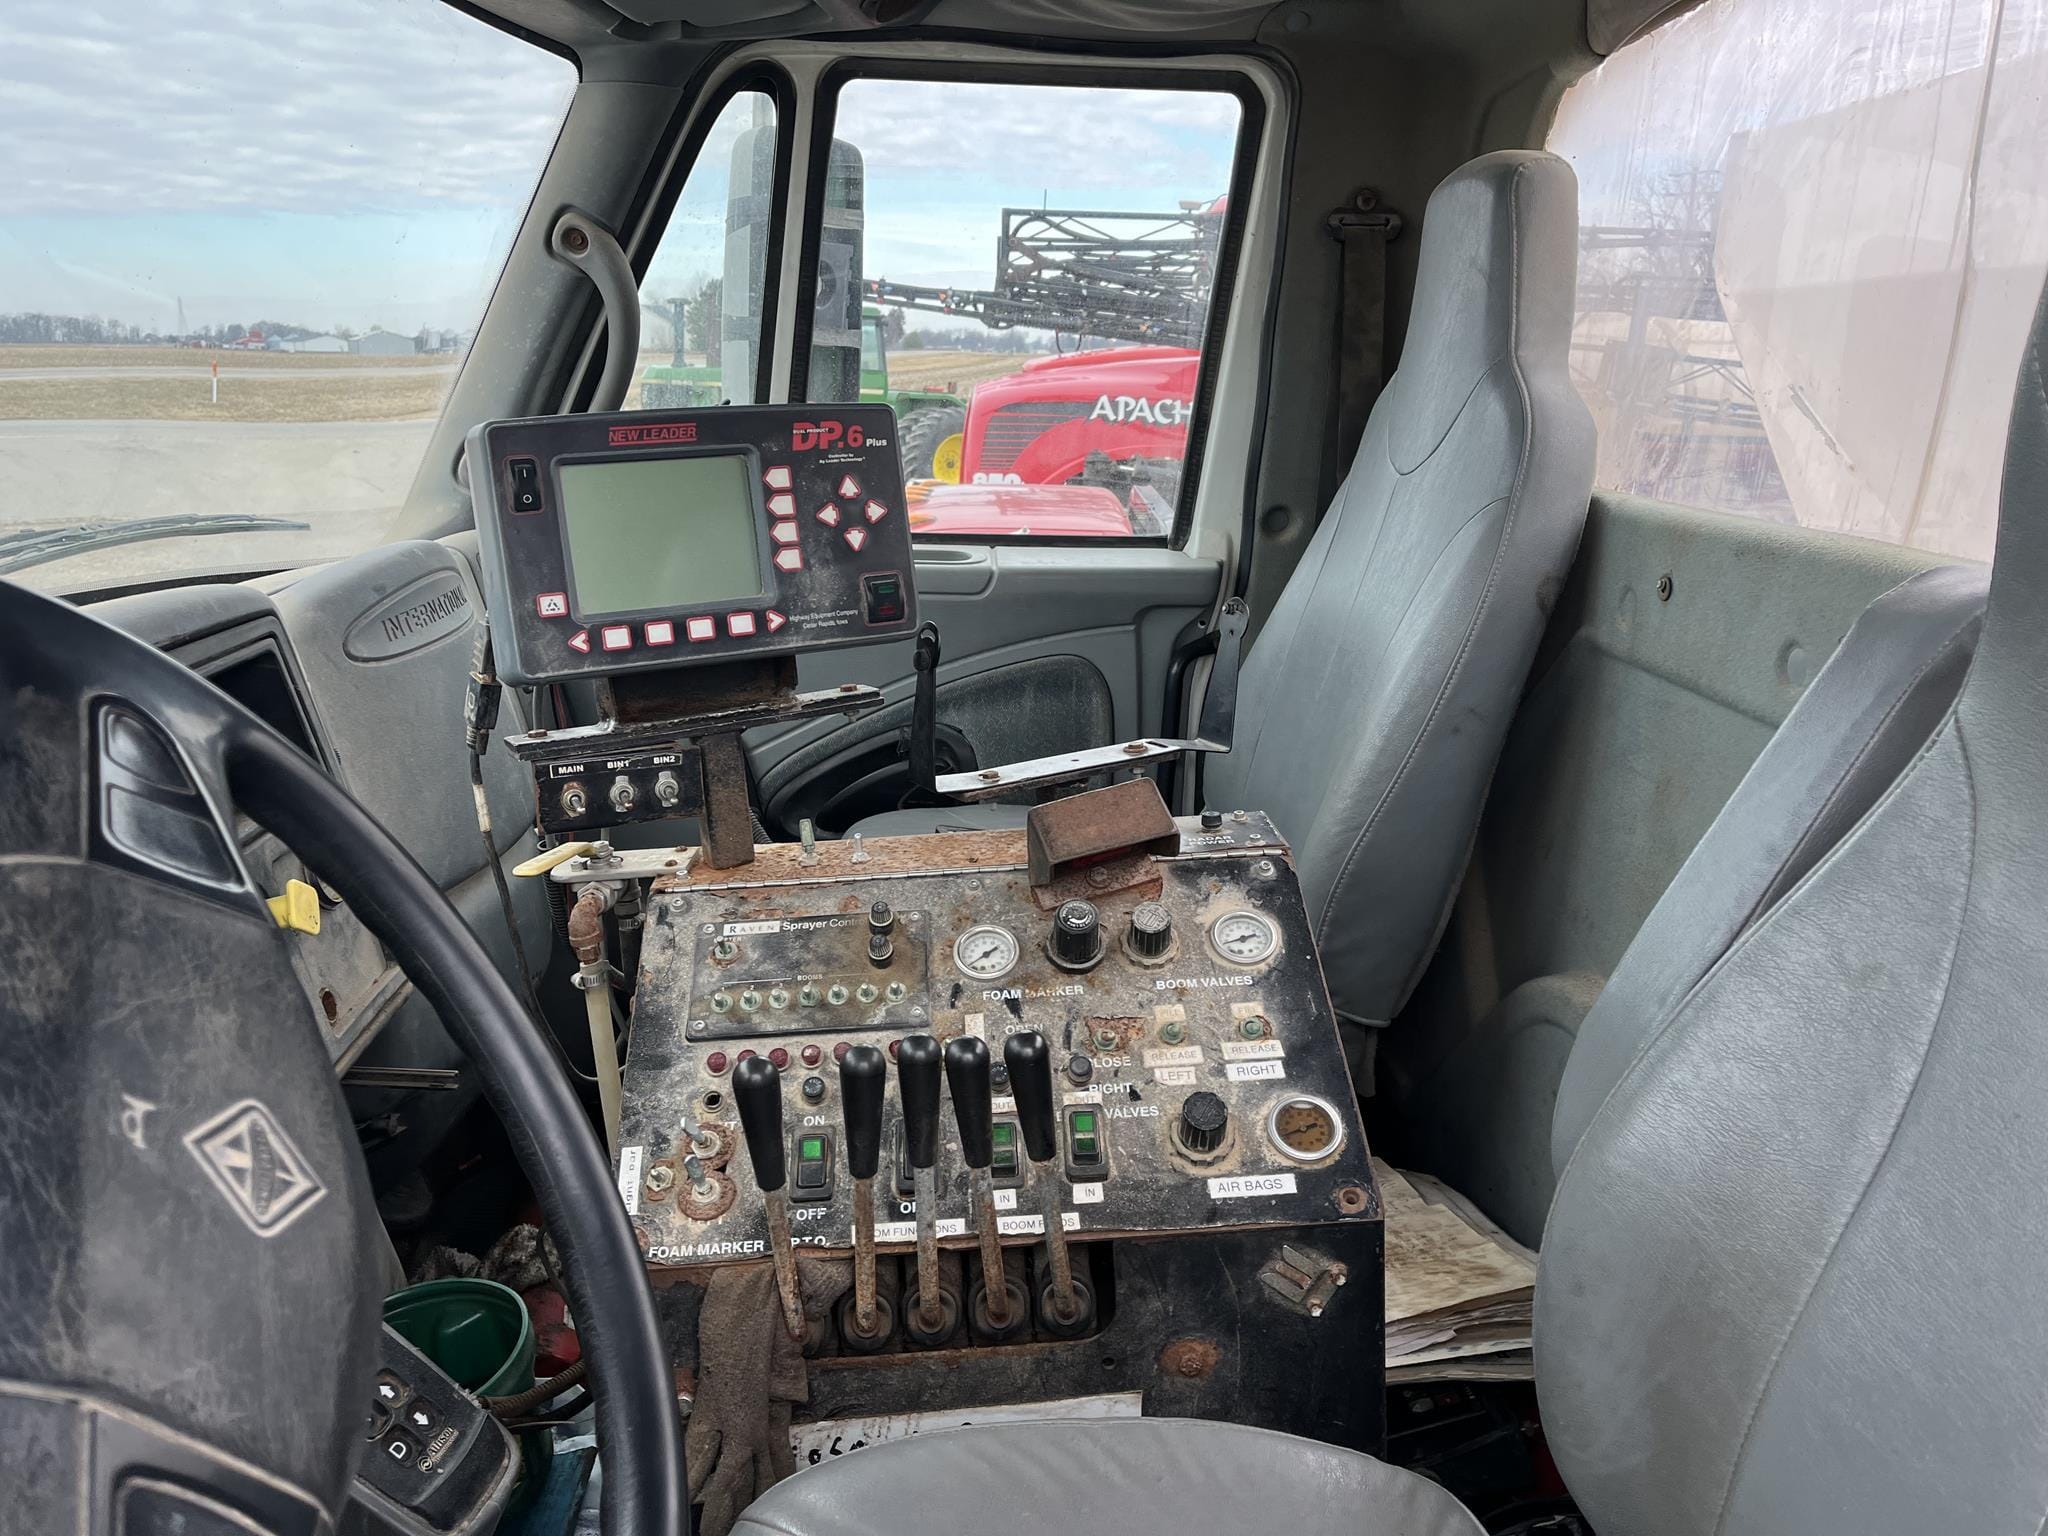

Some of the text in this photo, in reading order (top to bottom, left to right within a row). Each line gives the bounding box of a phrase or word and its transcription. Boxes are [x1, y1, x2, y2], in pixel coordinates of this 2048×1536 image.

[608, 427, 697, 442] NEW LEADER
[866, 438, 888, 447] Plus
[558, 756, 676, 774] MAIN BIN1 BIN2
[729, 923, 775, 934] RAVEN
[782, 920, 827, 933] Sprayer
[1156, 975, 1253, 990] BOOM VALVES
[983, 985, 1084, 1001] FOAM MARKER
[1231, 1044, 1277, 1054] RELEASE
[1151, 1050, 1198, 1061] RELEASE
[1160, 1070, 1192, 1082] LEFT
[1236, 1064, 1277, 1076] RIGHT
[1089, 1082, 1132, 1094] RIGHT
[1104, 1106, 1160, 1118] VALVES
[803, 1116, 825, 1127] ON
[1217, 1178, 1283, 1193] AIR BAGS
[999, 1194, 1010, 1203] IN
[1084, 1188, 1096, 1197] IN
[796, 1207, 827, 1220] OFF
[1002, 1220, 1036, 1231] BOOM
[648, 1240, 764, 1258] FOAM MARKER
[388, 1442, 407, 1459] D
